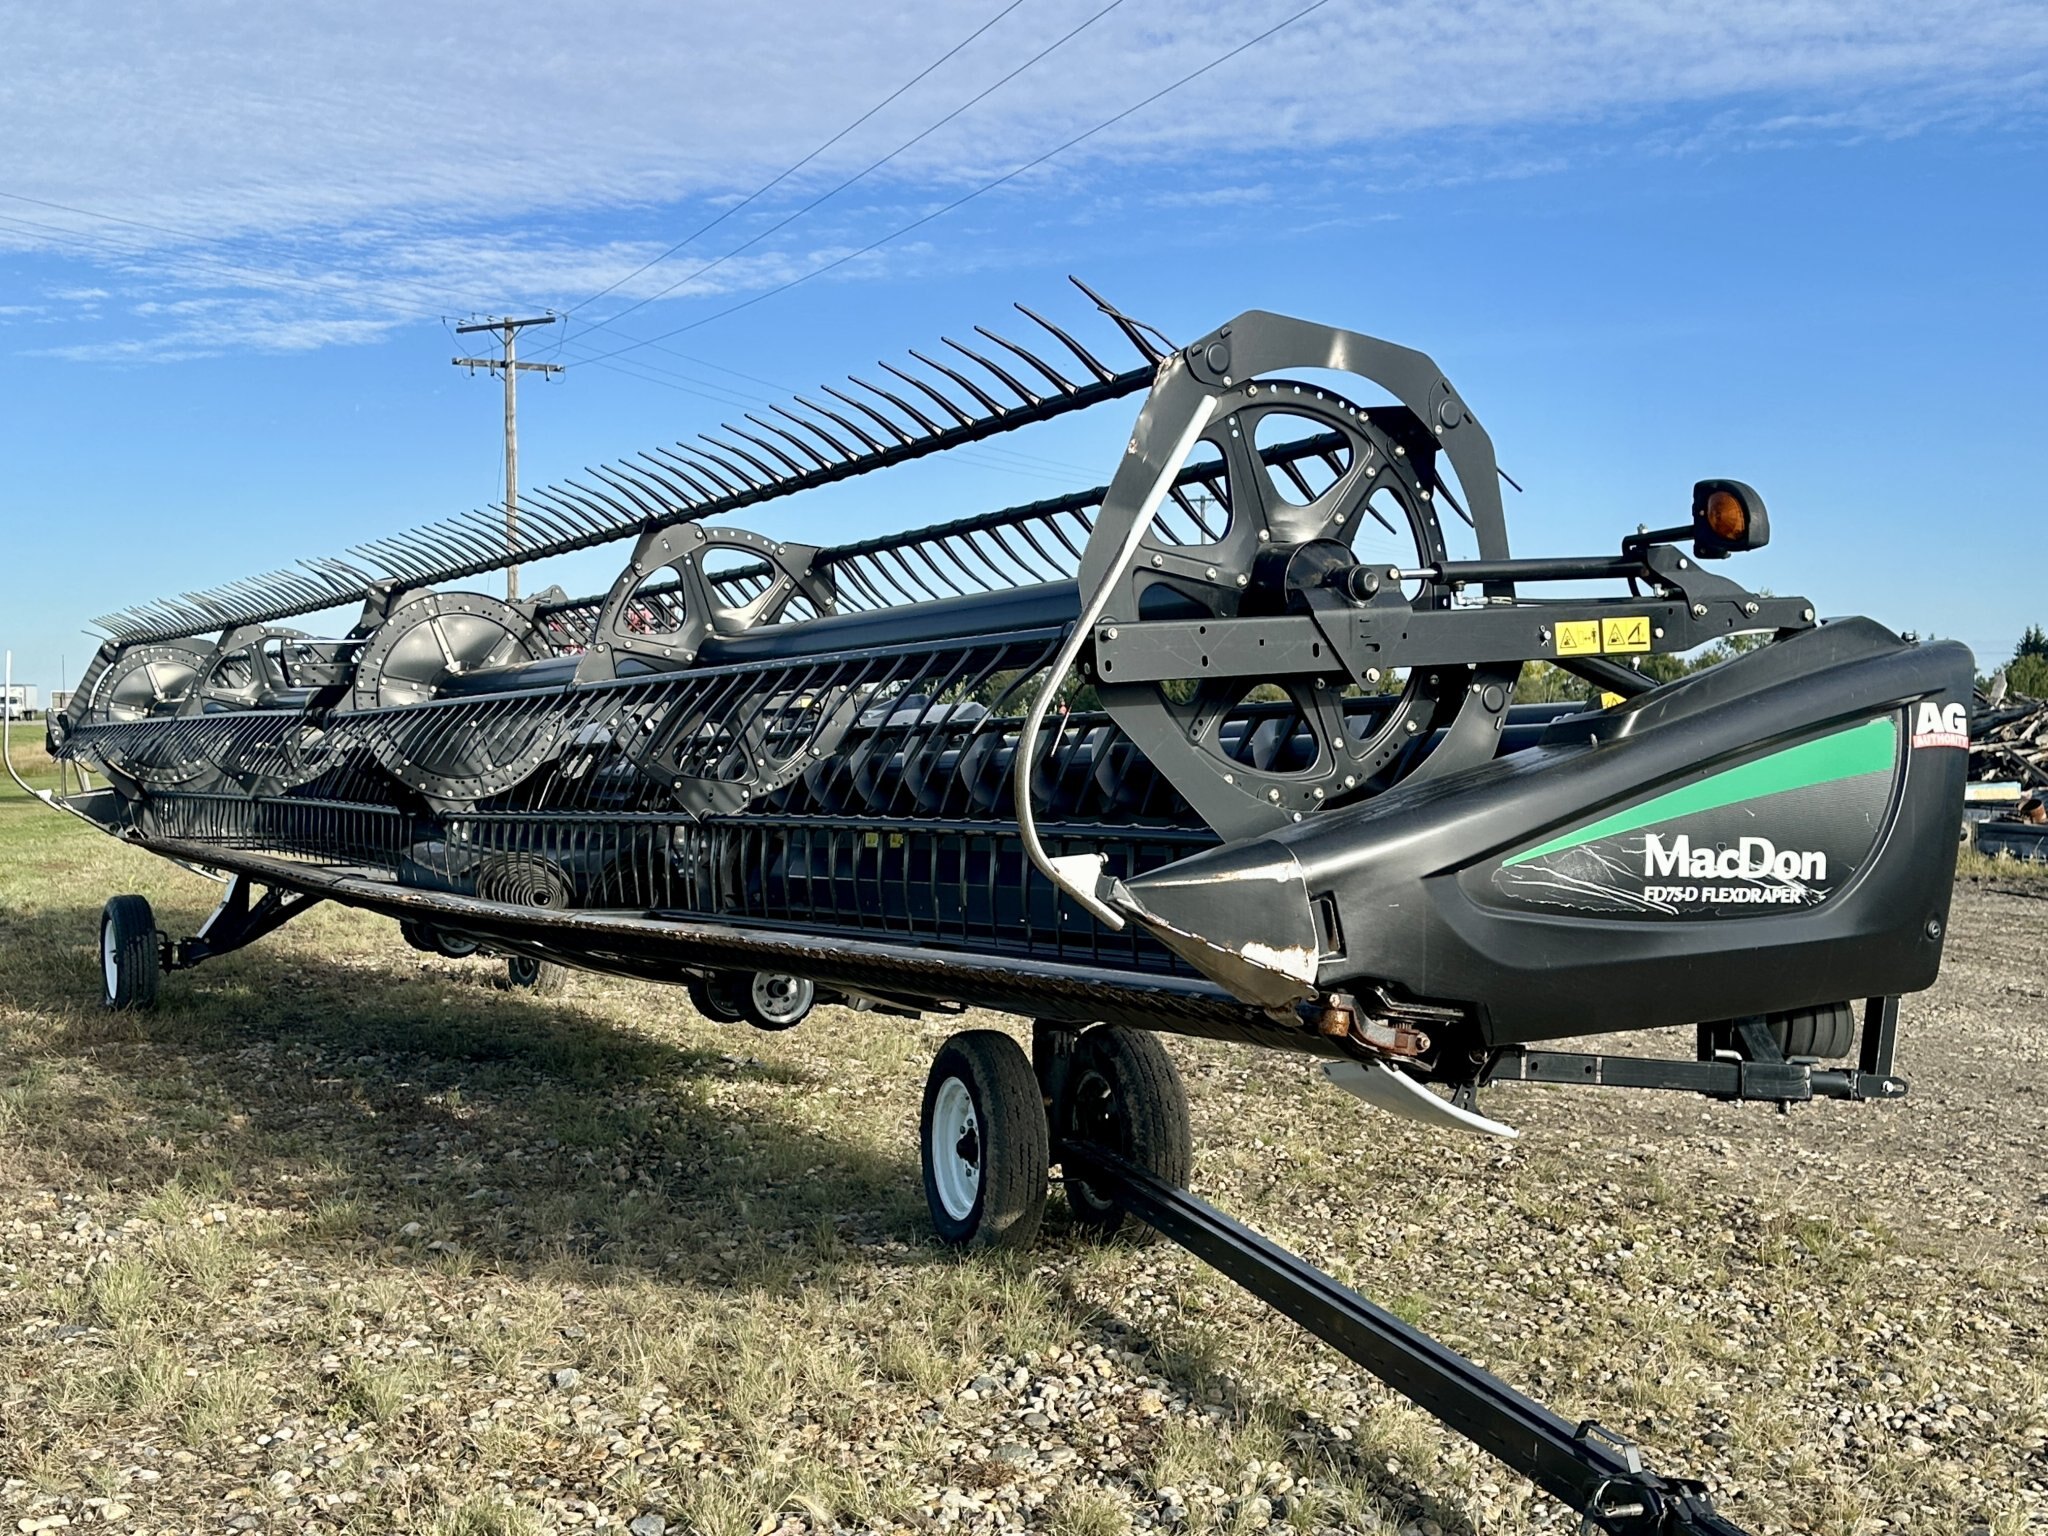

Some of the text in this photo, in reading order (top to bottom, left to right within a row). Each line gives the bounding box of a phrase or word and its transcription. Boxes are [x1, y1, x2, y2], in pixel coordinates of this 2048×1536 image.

[1916, 702, 1967, 736] AG
[1645, 833, 1827, 881] MacDon
[1644, 886, 1801, 904] FD75-D FLEXDRAPER
